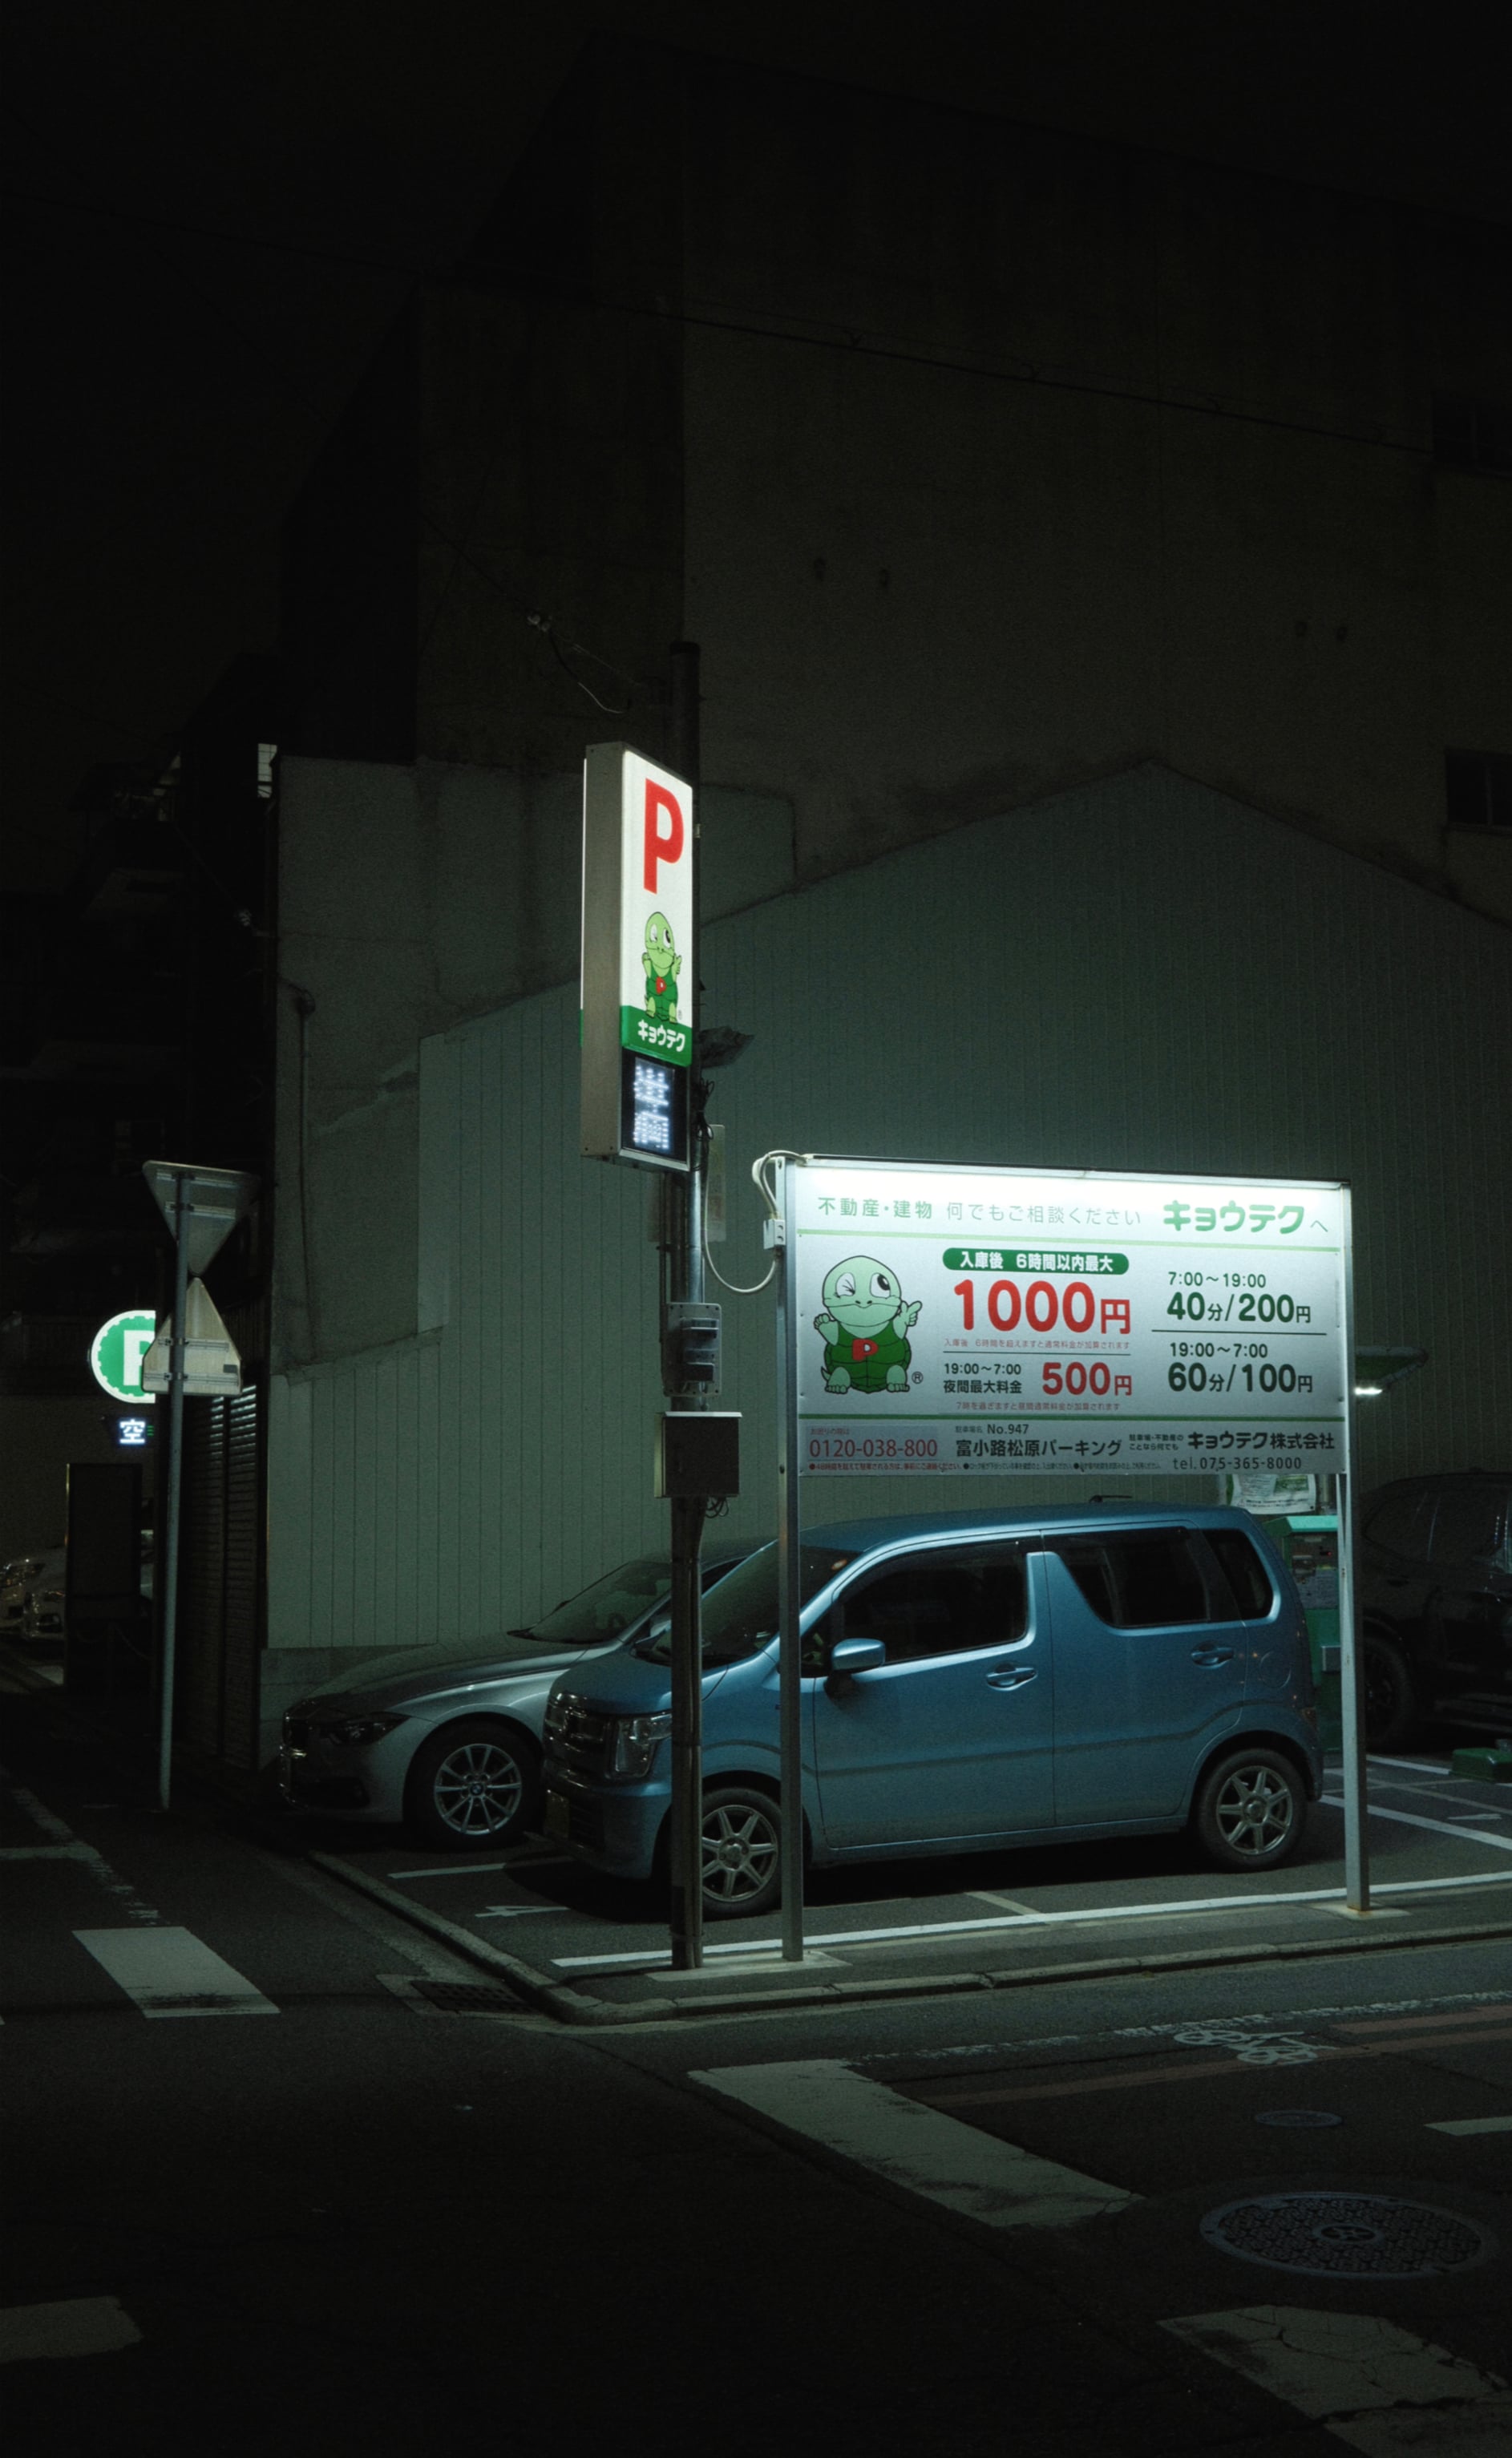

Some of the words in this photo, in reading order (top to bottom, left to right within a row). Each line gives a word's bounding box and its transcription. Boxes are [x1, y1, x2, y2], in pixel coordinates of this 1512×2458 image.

[644, 778, 685, 895] P
[656, 976, 667, 995] P
[637, 1019, 686, 1052] キョウテク
[818, 1198, 933, 1219] 不動産・建物
[947, 1202, 1142, 1226] 何でもご相談ください
[960, 1251, 1004, 1270] 入庫後
[1016, 1253, 1114, 1272] 6時間以内最大
[954, 1280, 1131, 1334] 1000円
[1166, 1292, 1312, 1324] 40分/200円
[851, 1338, 879, 1361] P
[943, 1380, 1022, 1394] 夜間最大料金
[1042, 1361, 1132, 1396] 500円
[1168, 1362, 1312, 1393] 60分/100円
[119, 1418, 146, 1444] 空
[987, 1424, 1029, 1434] No.947
[1187, 1432, 1335, 1450] キョウテク株式会社
[809, 1439, 938, 1457] 0120-038-800
[956, 1439, 1122, 1457] 富小路松原パーキング
